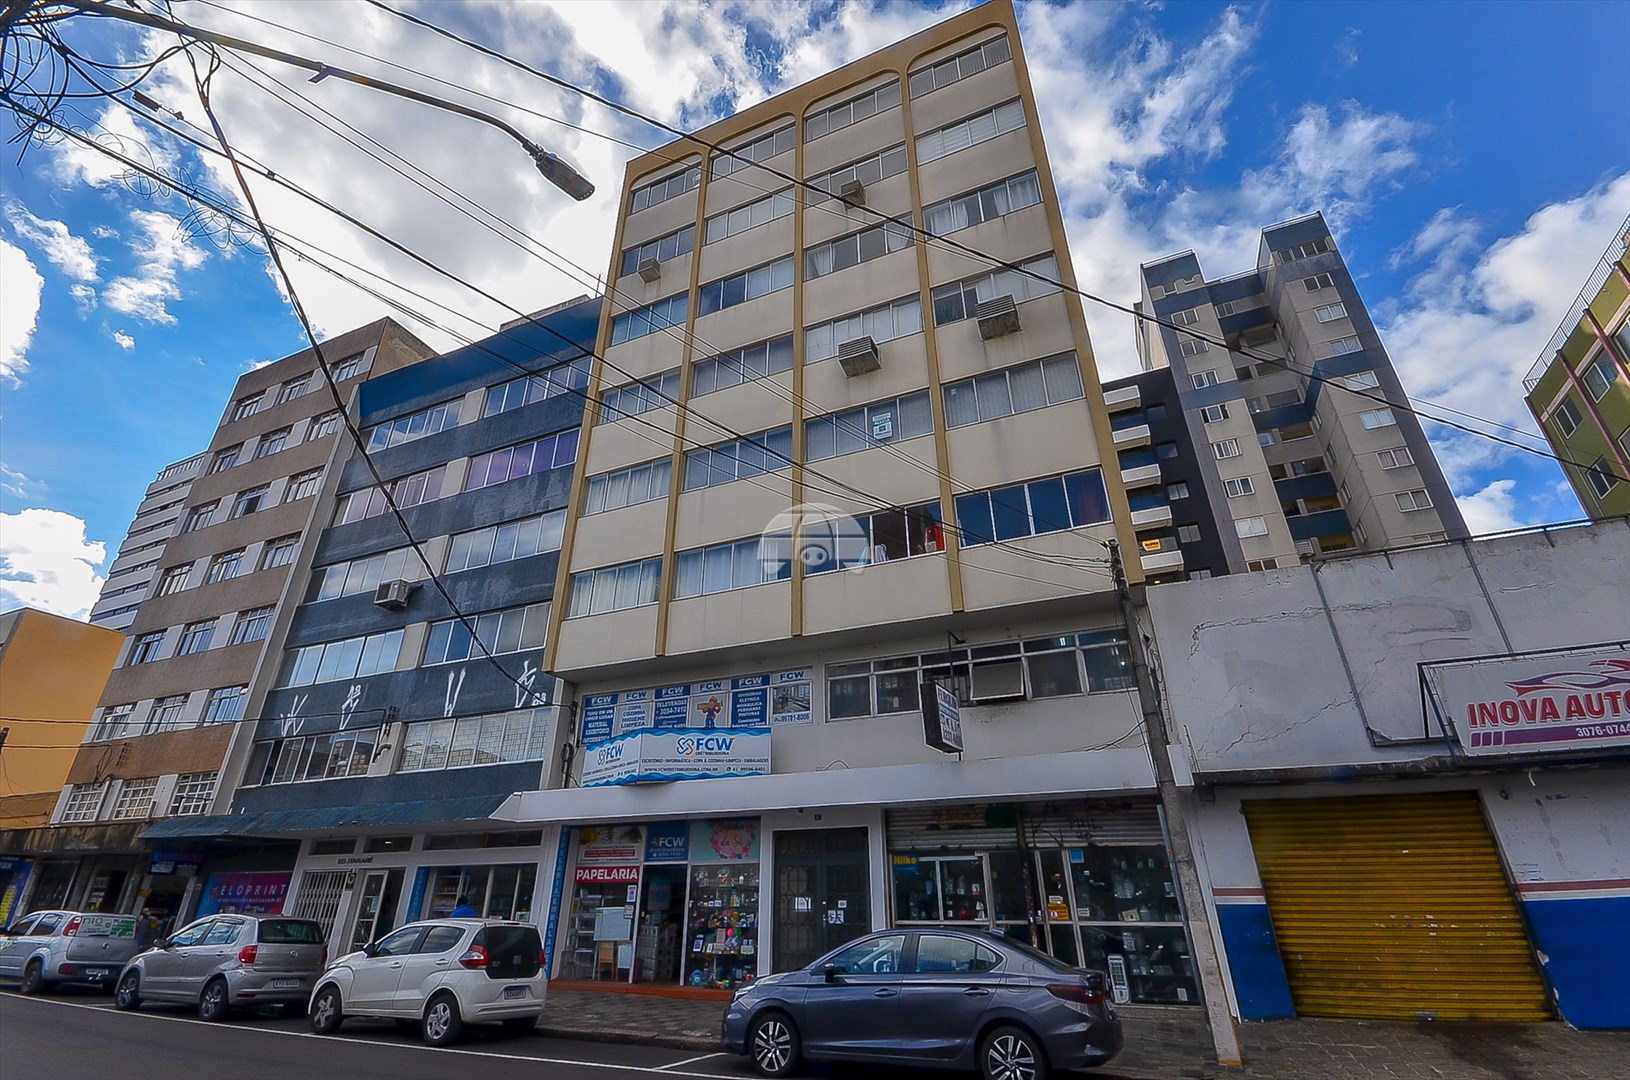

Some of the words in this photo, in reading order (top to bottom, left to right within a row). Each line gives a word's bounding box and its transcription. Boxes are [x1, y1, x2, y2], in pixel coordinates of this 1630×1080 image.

[780, 671, 805, 680] FCW
[700, 681, 722, 691] FCW
[739, 677, 762, 686] FCW
[625, 691, 647, 700] FCW
[662, 686, 684, 696] FCW
[591, 695, 612, 704] FCW
[1467, 696, 1561, 728] INOVA
[695, 737, 735, 751] FCW
[605, 743, 625, 760] FCW
[659, 836, 685, 847] FCW
[894, 855, 917, 865] Nilko
[576, 868, 638, 880] PAPELARIA
[220, 884, 287, 896] ELOPRINT
